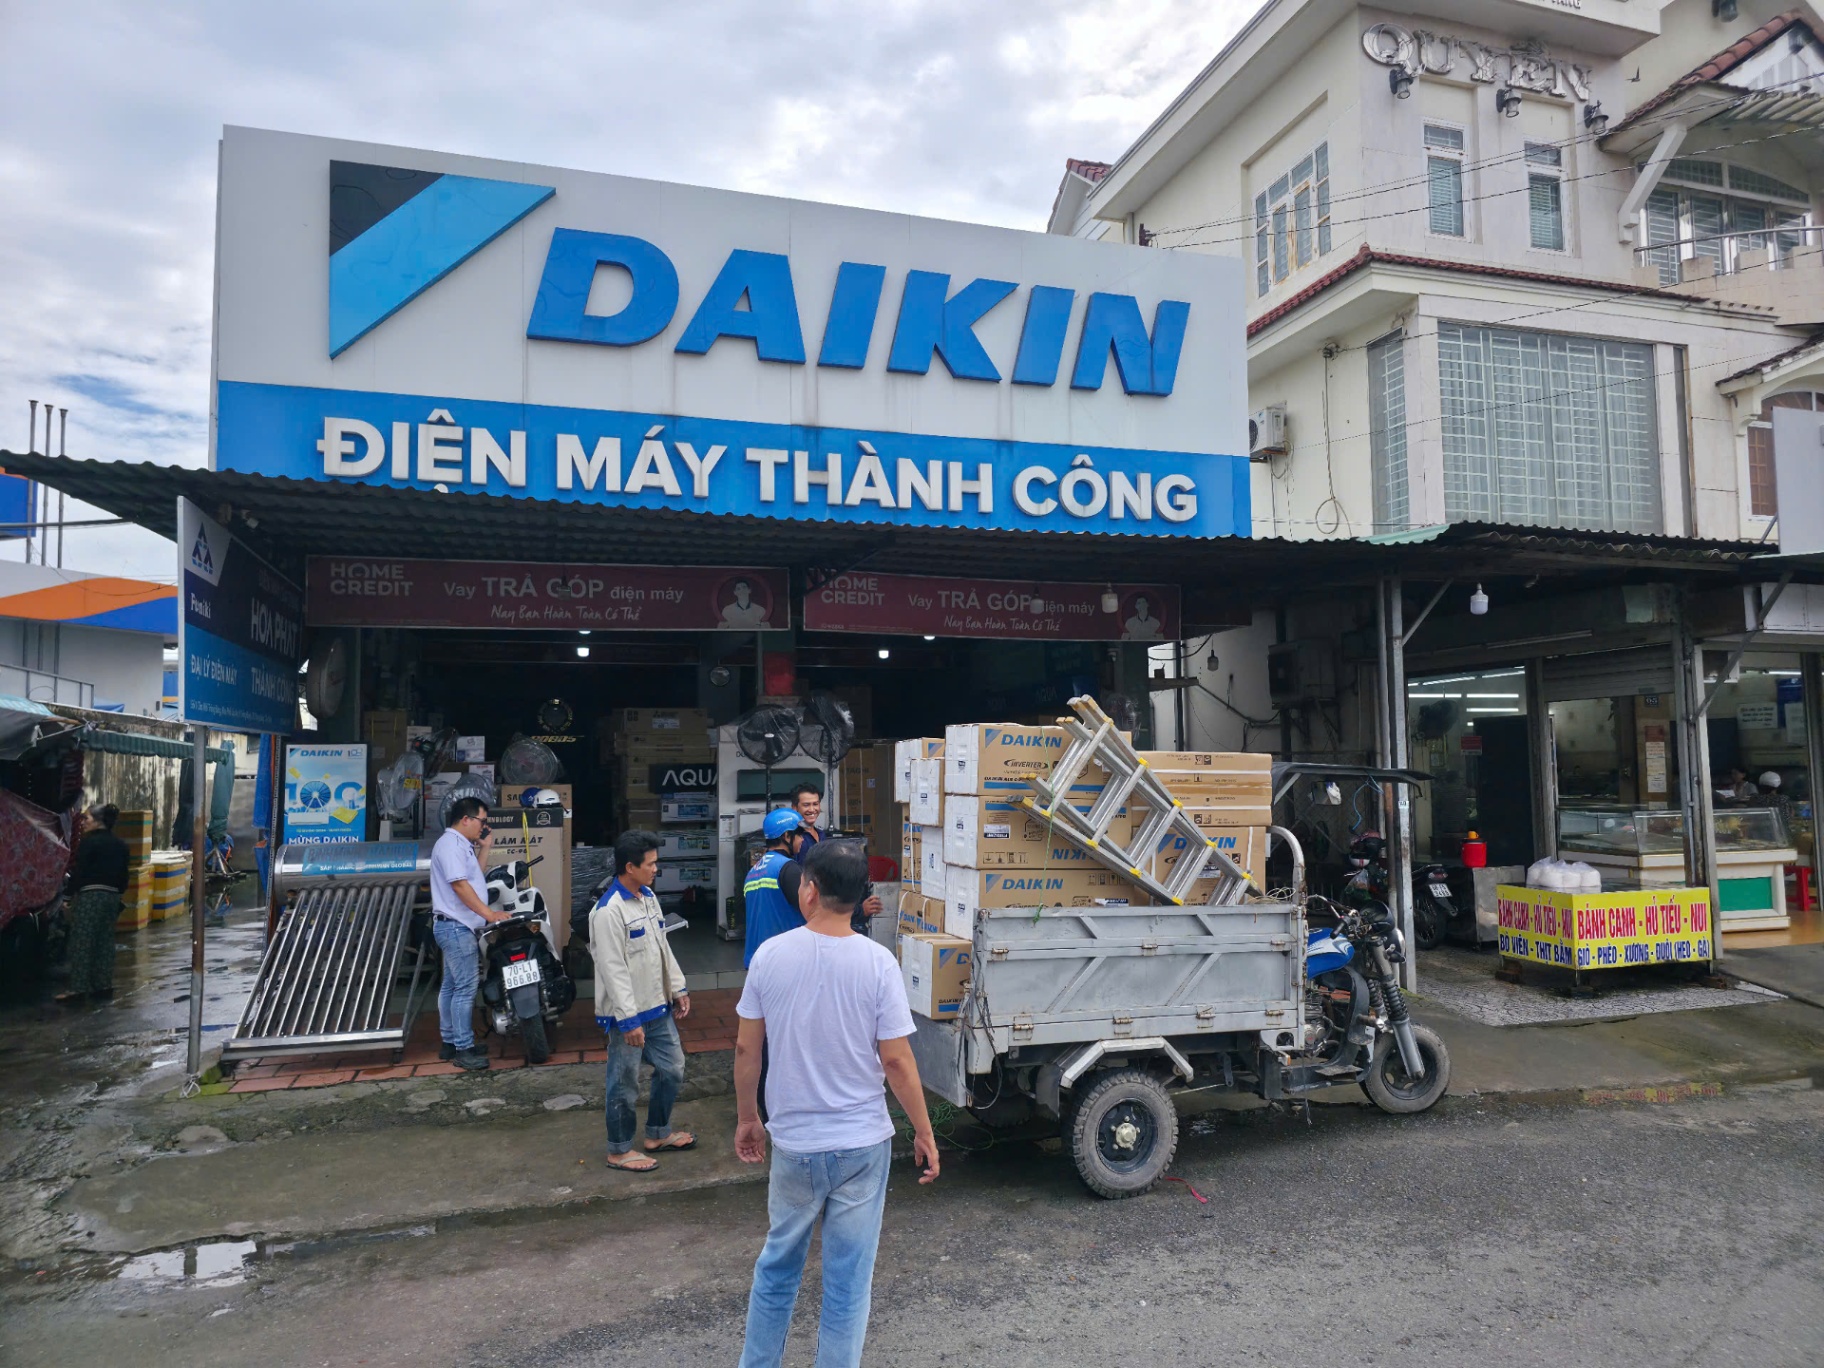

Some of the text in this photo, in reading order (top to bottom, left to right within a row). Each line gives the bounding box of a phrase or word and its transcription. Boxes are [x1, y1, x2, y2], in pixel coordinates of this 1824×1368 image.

[527, 227, 1191, 397] DAIKIN
[317, 408, 1198, 523] ĐIỆN MÁY THÀNH CÔNG
[330, 562, 404, 579] HOME
[330, 579, 413, 596] CREDIT
[443, 573, 684, 603] Vay TRẢ GÓP điện máy
[821, 590, 885, 606] CREDIT
[908, 588, 1095, 617] Vay TRẢ GÓP iện máy
[491, 604, 642, 624] Nay Bạn Hoàn Toàn Có Thể
[944, 615, 963, 633] Nay
[985, 617, 1007, 630] Hoàn
[1010, 617, 1030, 631] Toàn
[1032, 619, 1044, 631] Có
[1001, 734, 1062, 748] DAIKIN
[300, 749, 342, 757] DAIKIN
[323, 836, 359, 844] DAIKIN
[1002, 878, 1063, 890] DAIKIN
[1514, 901, 1530, 931] CANH
[1577, 894, 1707, 940] BÁNH CANH HỦ TIẾU NUI
[1499, 931, 1510, 953] BÒ
[1511, 934, 1529, 956] VIÊN
[1535, 941, 1552, 965] THỊT
[1577, 943, 1591, 967] GIÒ
[1597, 942, 1617, 965] PHÈO
[507, 962, 532, 976] 70-L1
[507, 971, 538, 988] 966.88
